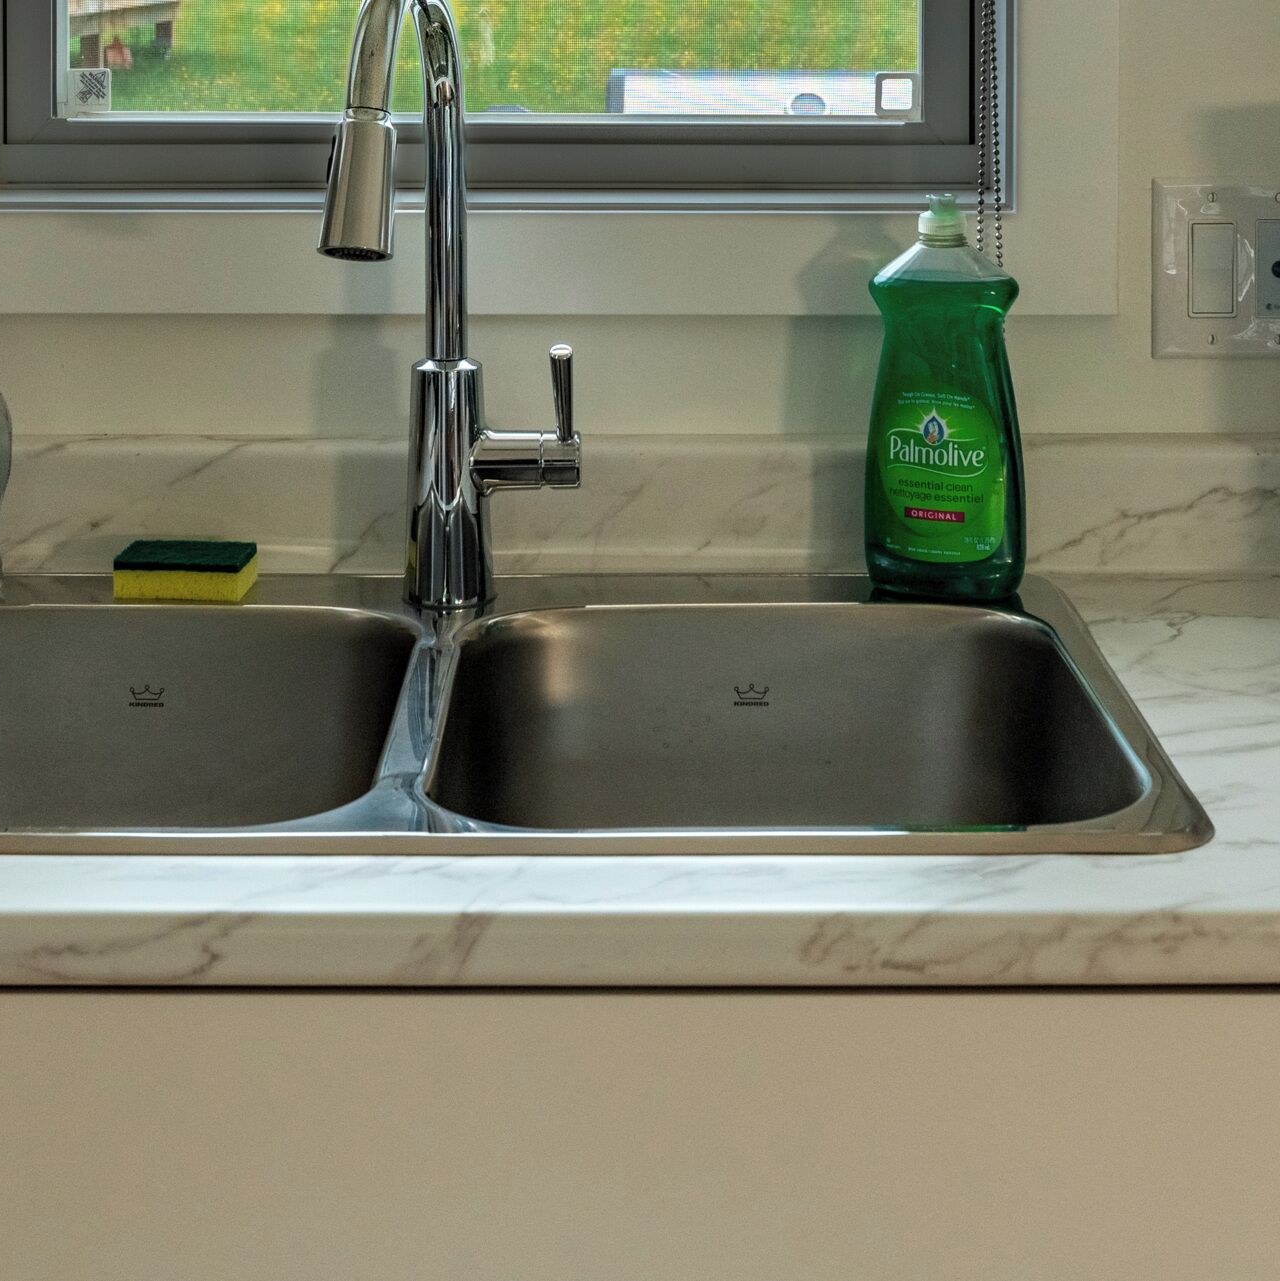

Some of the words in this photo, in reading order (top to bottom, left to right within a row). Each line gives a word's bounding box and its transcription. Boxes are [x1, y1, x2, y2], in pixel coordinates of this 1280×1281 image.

[890, 435, 984, 467] Palmolive
[898, 479, 944, 490] essential
[946, 483, 973, 492] clean
[890, 488, 932, 502] nettoyage
[934, 493, 984, 503] essentiel
[911, 510, 956, 520] ORIGINAL
